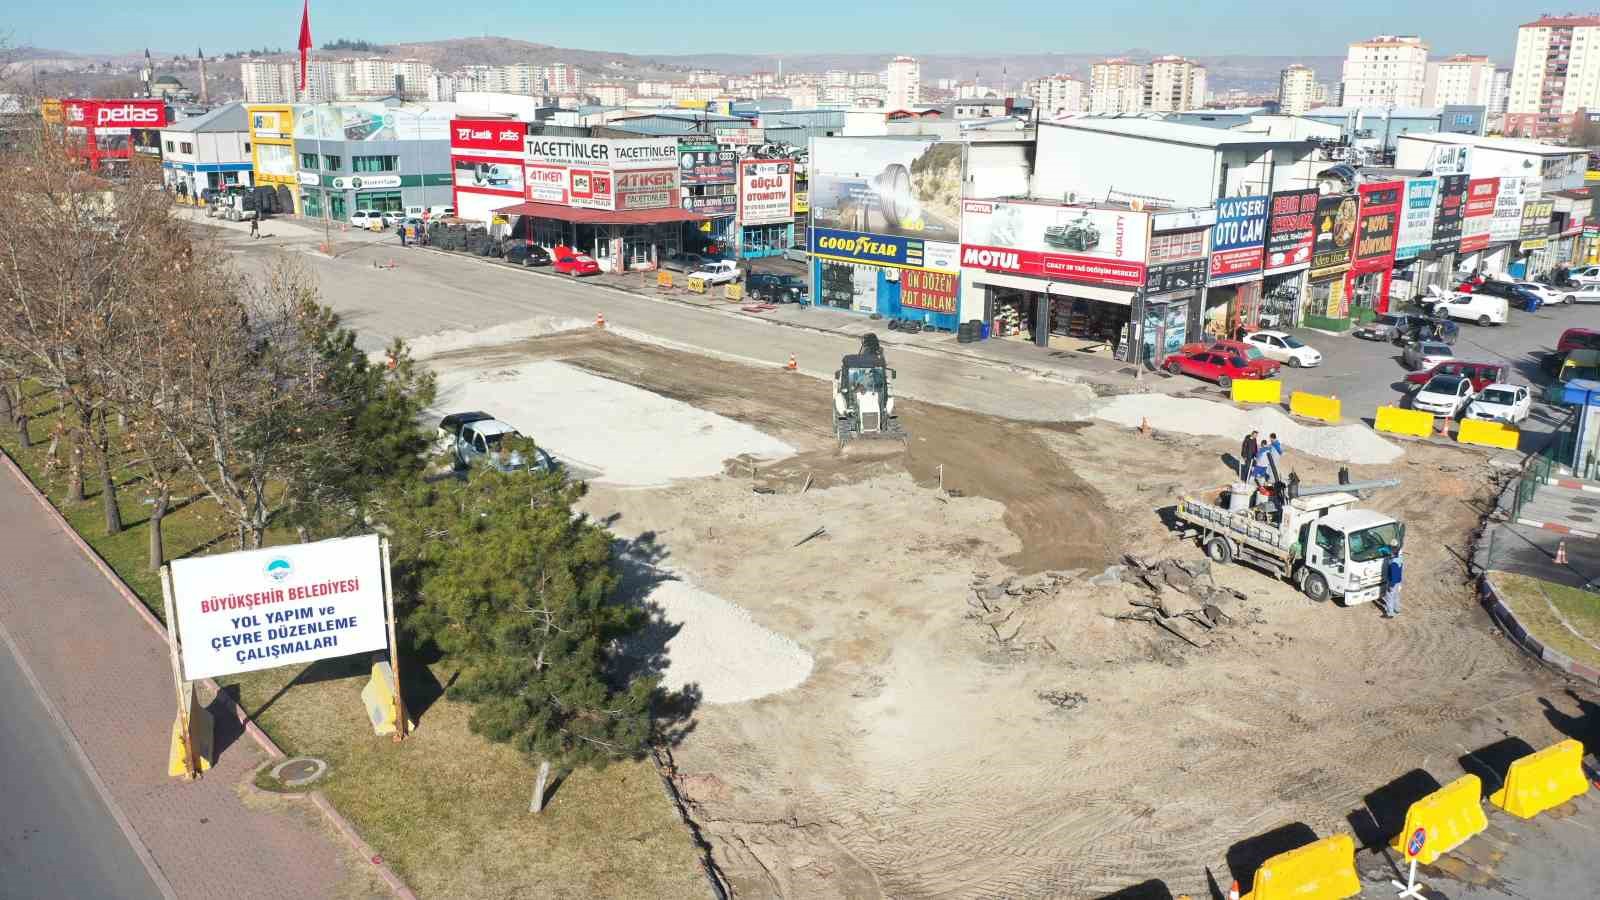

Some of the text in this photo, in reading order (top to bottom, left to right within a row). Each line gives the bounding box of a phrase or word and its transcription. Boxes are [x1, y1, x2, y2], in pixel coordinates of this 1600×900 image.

[97, 104, 159, 125] petlas
[527, 140, 609, 159] TACETTİNLER
[616, 144, 676, 159] TACETTİNLER
[751, 175, 783, 190] GÜÇLÜ
[966, 203, 992, 213] MOTUL
[1116, 215, 1126, 257] QUALITY
[1216, 221, 1239, 246] OTO
[1240, 218, 1265, 243] CAM
[819, 236, 897, 257] GOODYEAR
[963, 248, 1021, 270] MOTUL
[201, 577, 360, 614] BÜYÜKŞEHİR BELEDİYESİ
[231, 605, 336, 630] YOL YAPIM ve
[211, 616, 358, 650] ÇEVRE DÜZENLEME
[236, 635, 338, 664] ÇALIŞMALARI
